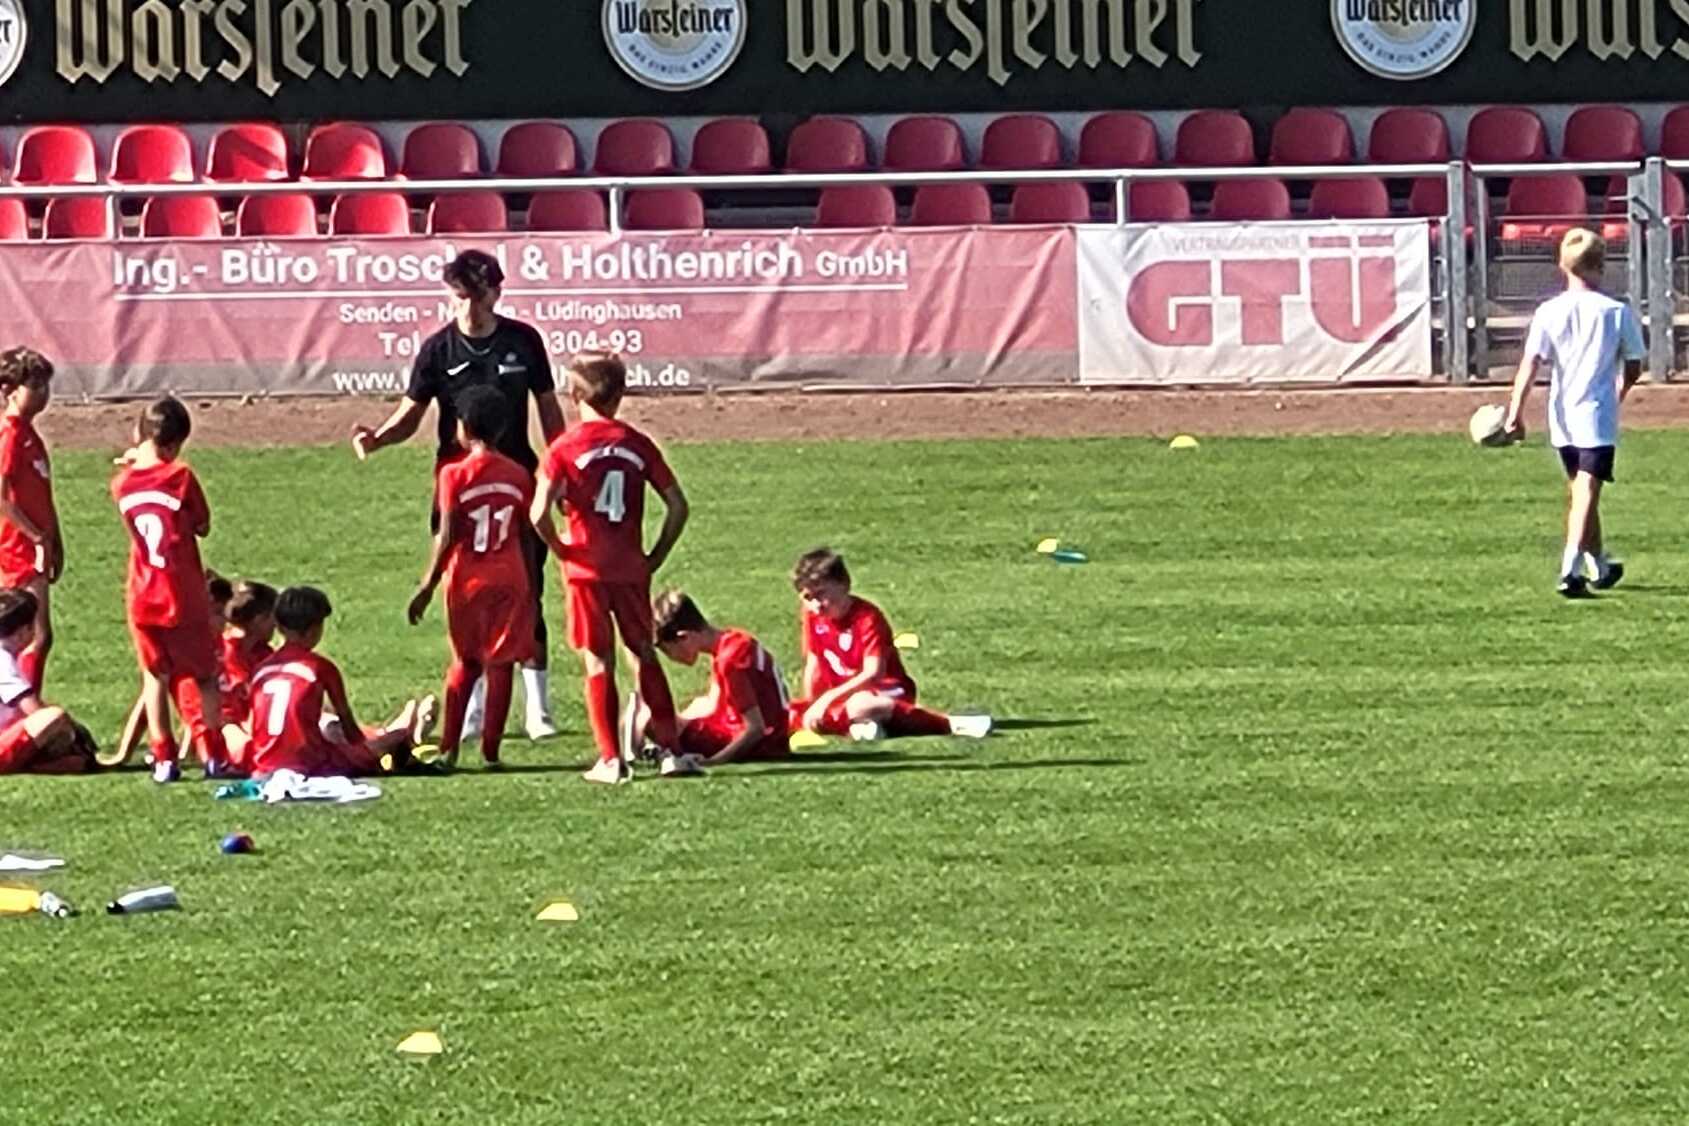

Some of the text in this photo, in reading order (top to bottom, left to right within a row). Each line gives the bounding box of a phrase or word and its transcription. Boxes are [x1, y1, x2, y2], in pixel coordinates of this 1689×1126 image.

[222, 243, 318, 284] Büro
[520, 243, 549, 281] &
[563, 241, 802, 280] Holthenrich
[816, 248, 908, 278] GmbH
[340, 302, 418, 323] Senden
[1127, 235, 1396, 346] GTÜ
[594, 470, 626, 522] 4
[468, 504, 514, 552] 11
